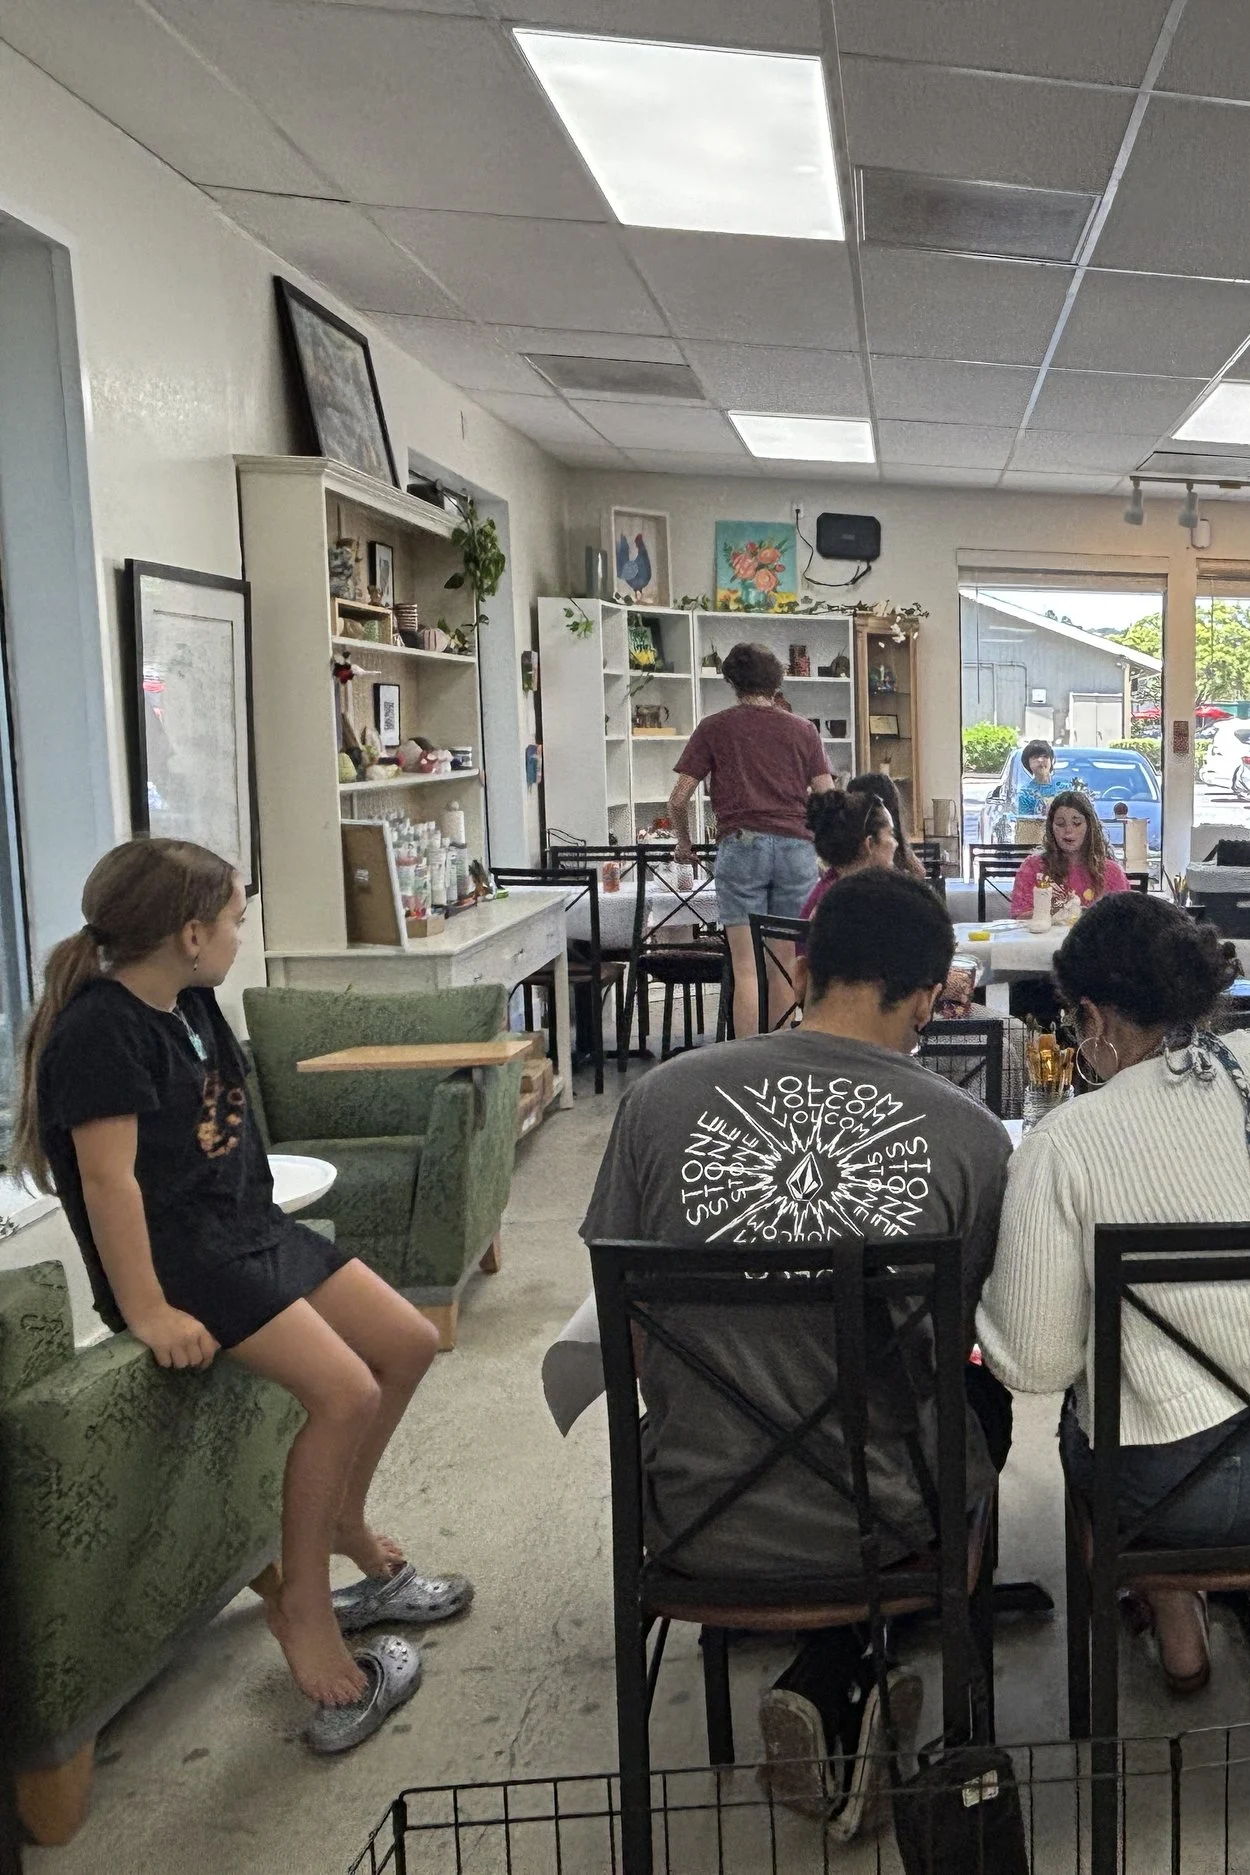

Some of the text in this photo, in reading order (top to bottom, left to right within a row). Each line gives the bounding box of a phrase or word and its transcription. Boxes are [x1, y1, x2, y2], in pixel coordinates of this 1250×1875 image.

[744, 1075, 903, 1118] VOLCOM
[756, 1093, 886, 1126] VOLCOM
[772, 1110, 870, 1139] VOLCOM
[682, 1111, 725, 1226] STONE
[704, 1123, 741, 1215] STONE
[728, 1134, 759, 1202] STONE
[853, 1152, 884, 1221] STONE
[871, 1142, 908, 1232] STONE
[884, 1136, 931, 1236] STONE
